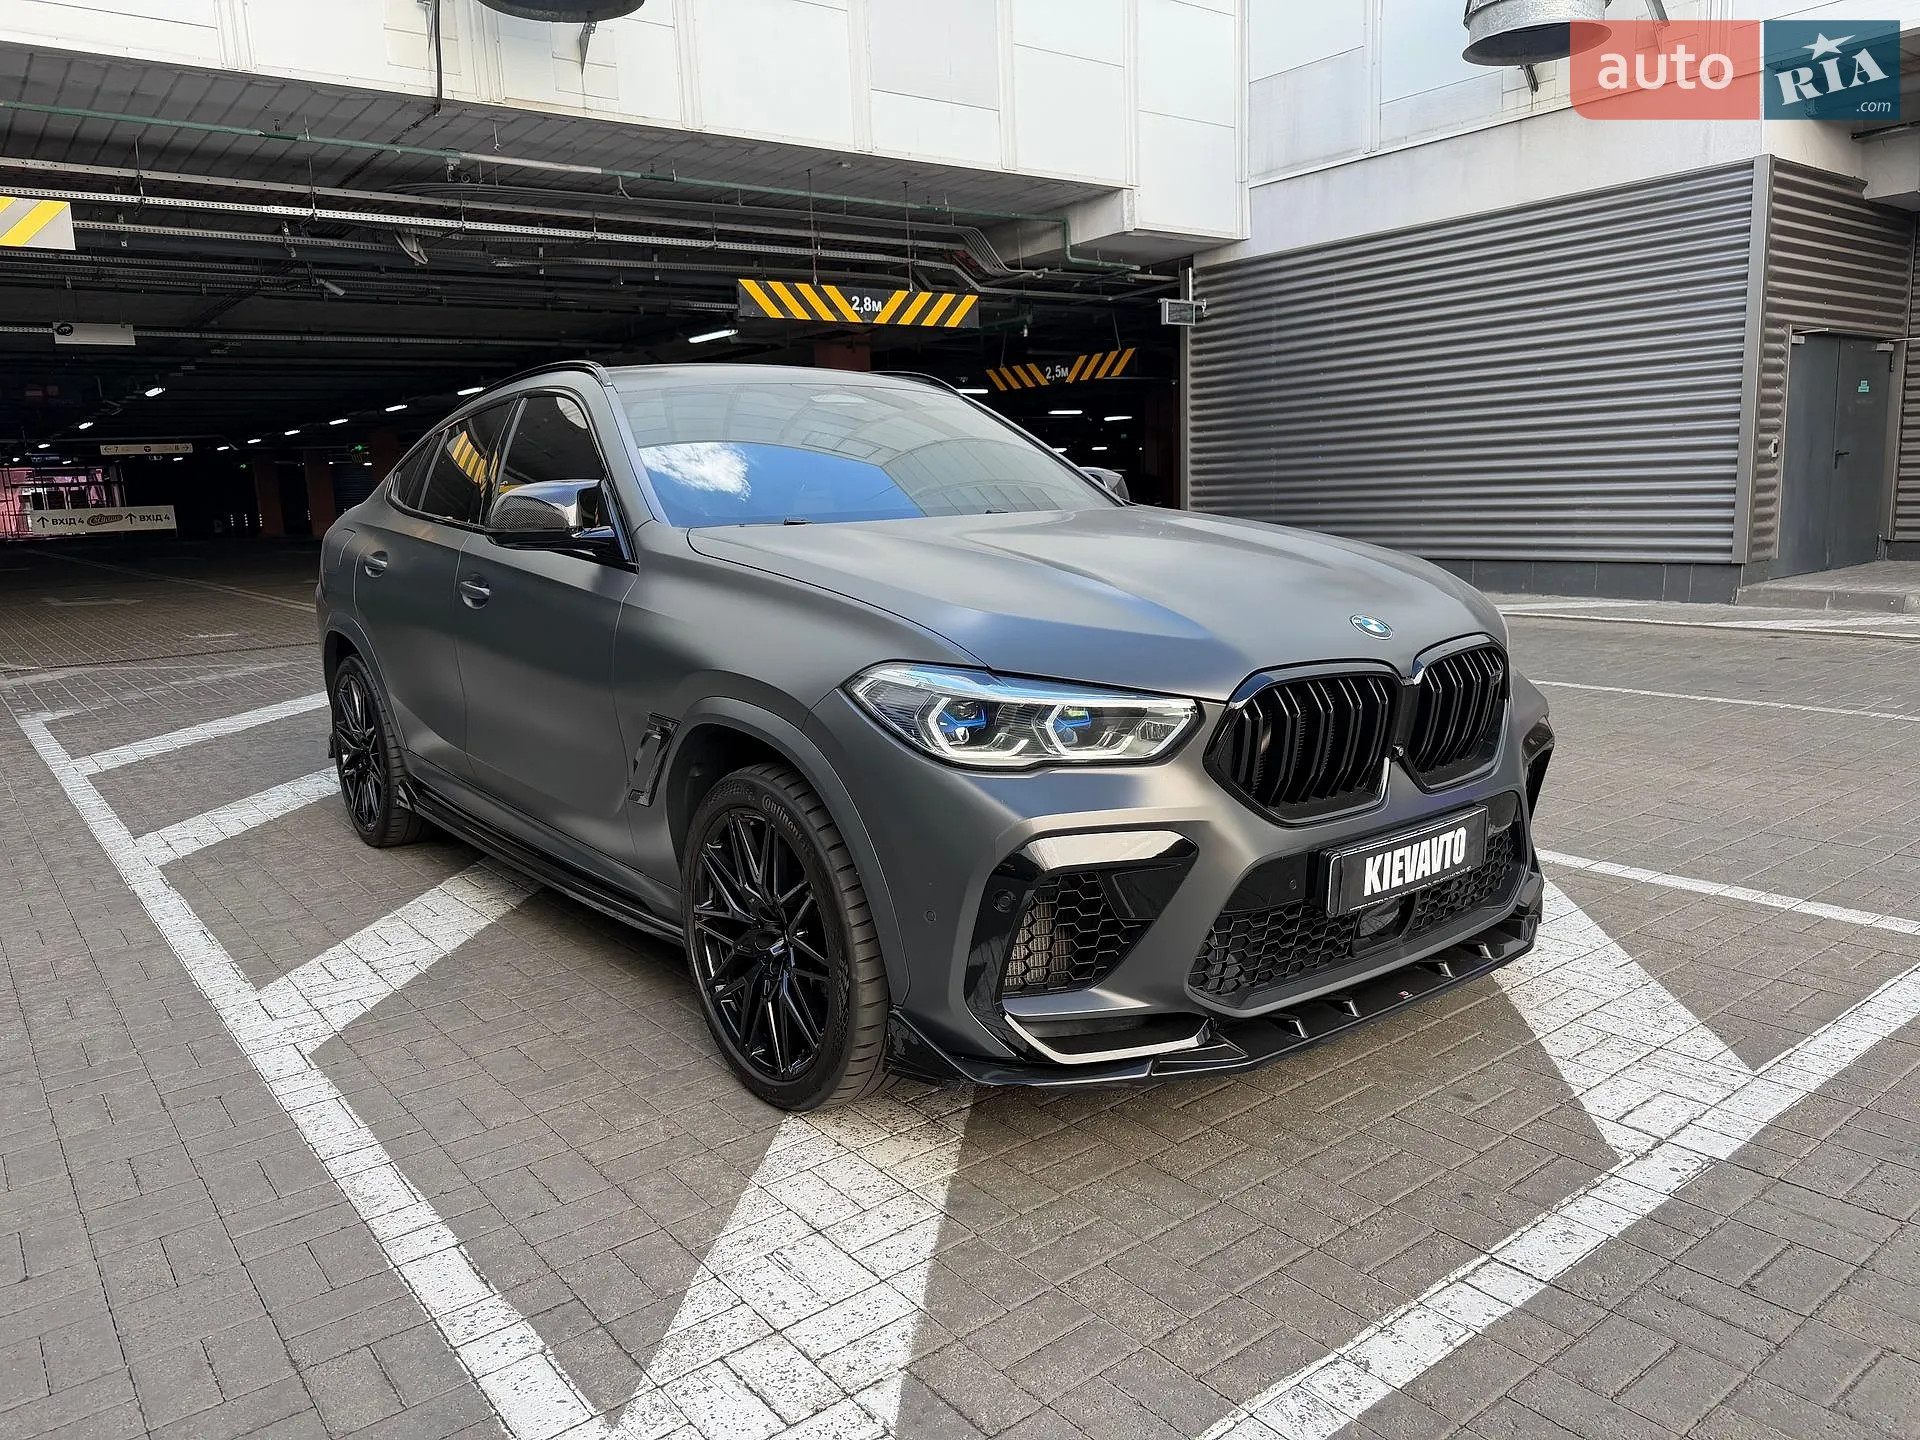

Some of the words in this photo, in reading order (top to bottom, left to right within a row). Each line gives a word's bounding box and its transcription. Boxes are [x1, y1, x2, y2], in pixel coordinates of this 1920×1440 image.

[851, 295, 882, 314] 2,8м
[51, 517, 77, 526] ВХІД
[139, 513, 163, 523] ВХІД
[1363, 826, 1467, 897] KIEVAVTO
